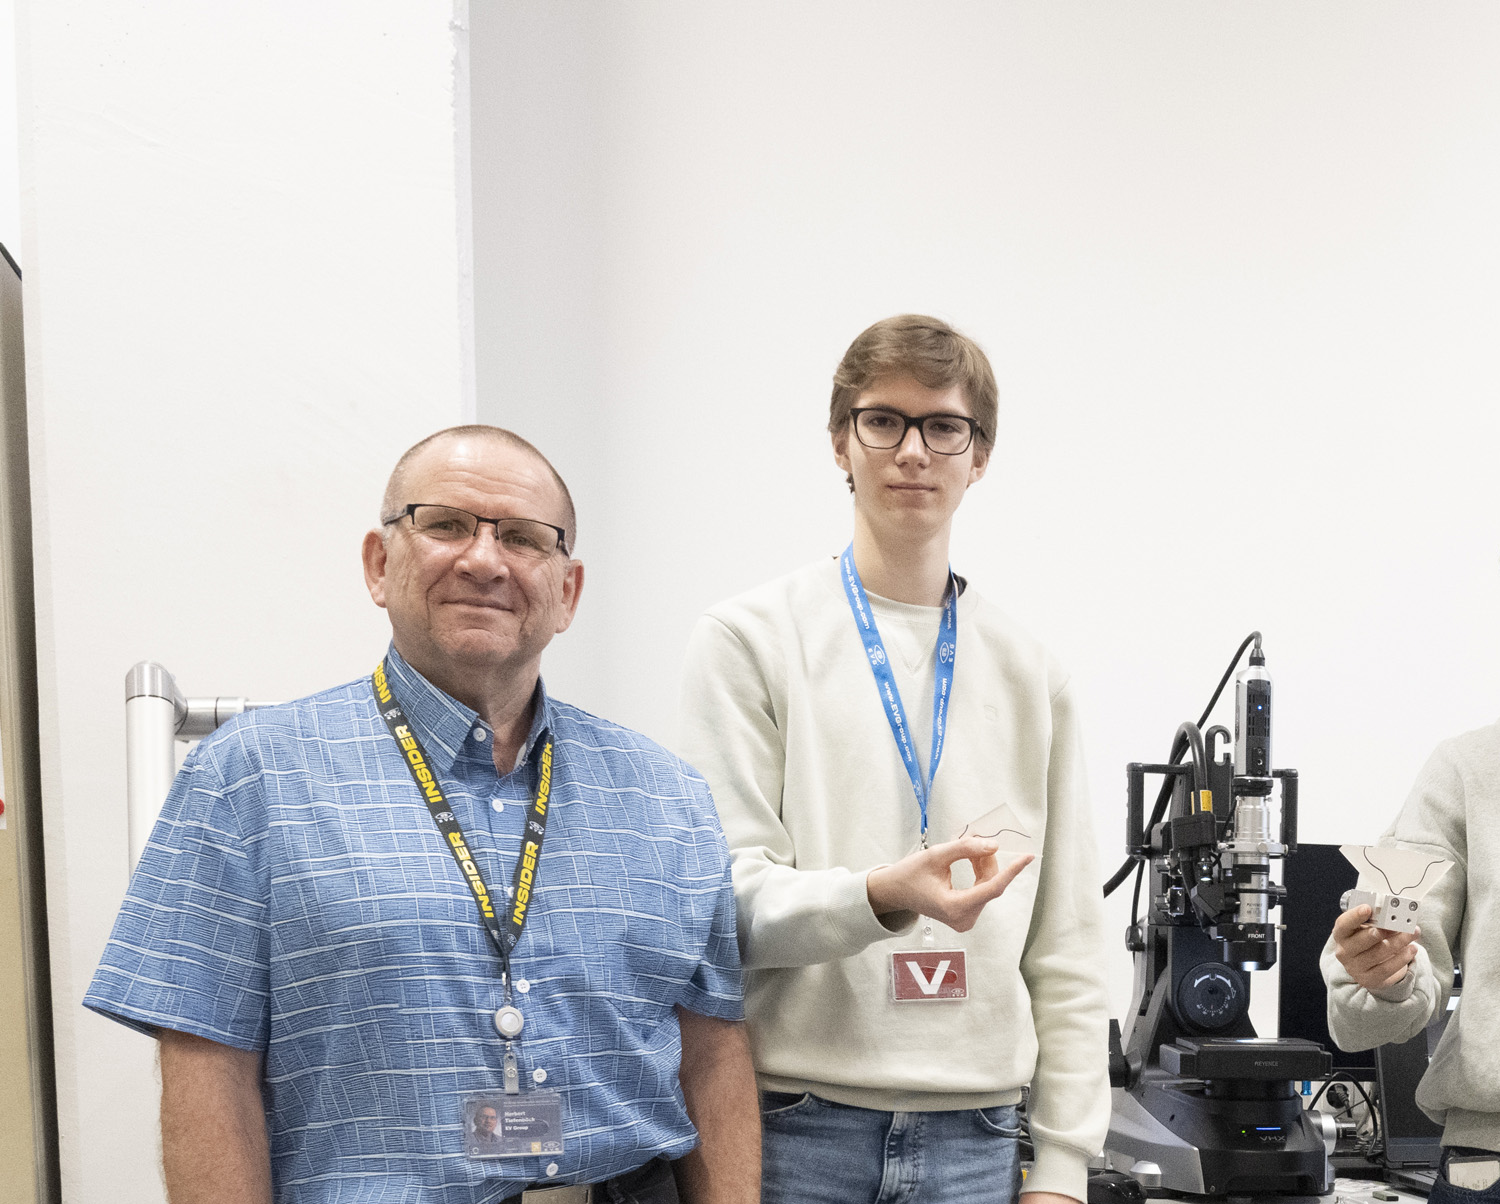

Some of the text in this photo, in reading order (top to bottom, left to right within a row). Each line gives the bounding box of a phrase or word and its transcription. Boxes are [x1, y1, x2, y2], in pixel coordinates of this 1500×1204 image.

[844, 557, 870, 630] www.EVGroup.com
[935, 677, 947, 760] www.EVGroup.com
[395, 724, 443, 803] INSIDER
[448, 831, 494, 918] INSIDER
[513, 841, 539, 925] INSIDER
[905, 960, 951, 995] V
